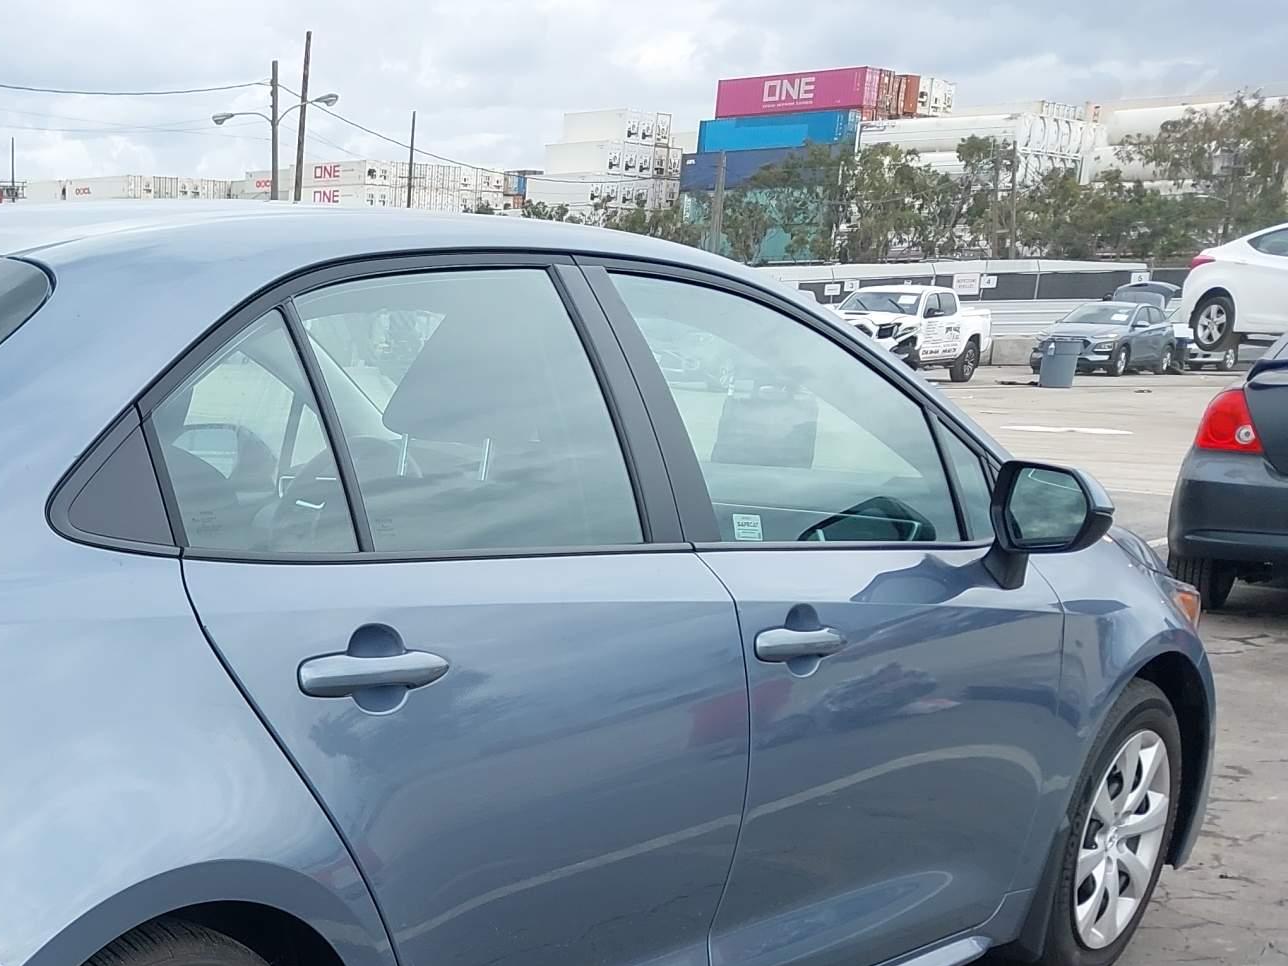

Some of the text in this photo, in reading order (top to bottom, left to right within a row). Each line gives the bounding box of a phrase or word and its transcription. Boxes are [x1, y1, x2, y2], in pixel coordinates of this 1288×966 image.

[763, 77, 815, 102] ONE
[314, 165, 340, 179] ONE
[313, 190, 340, 204] ONE
